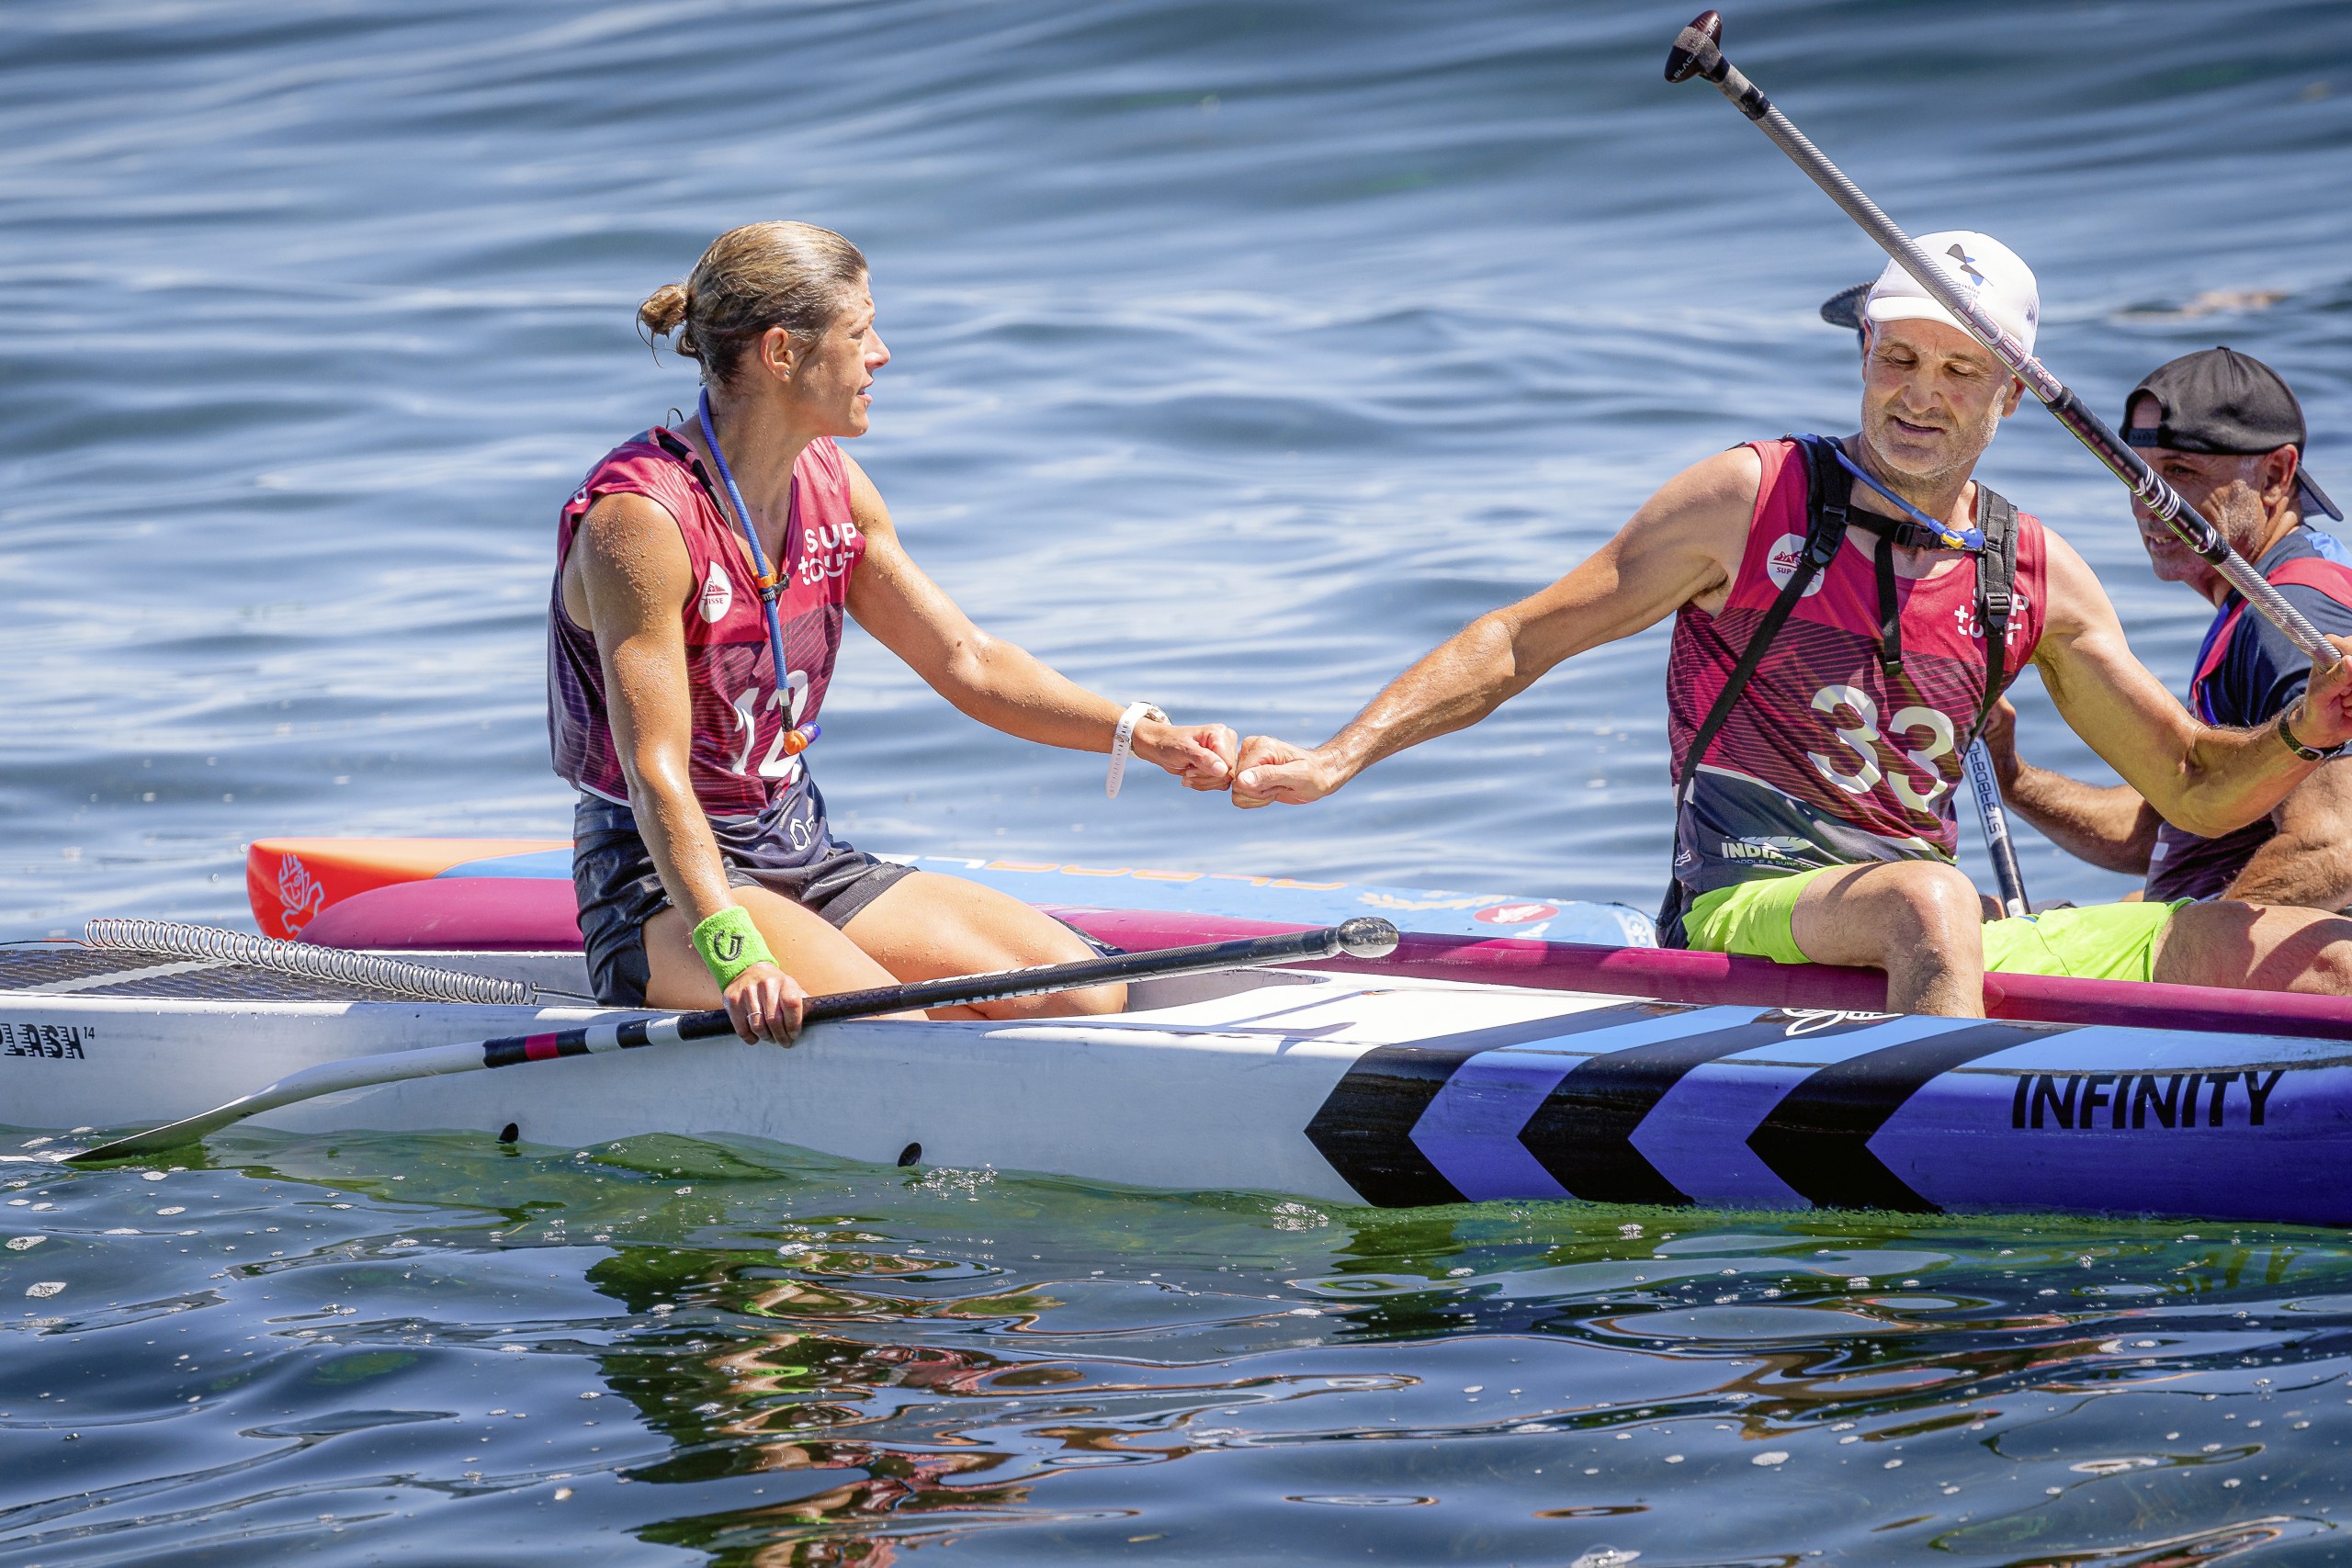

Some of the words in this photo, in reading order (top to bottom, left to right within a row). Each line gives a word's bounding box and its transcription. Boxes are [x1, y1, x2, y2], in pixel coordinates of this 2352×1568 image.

[1673, 51, 1698, 80] BLAC
[804, 522, 857, 554] SUP
[1776, 567, 1792, 575] SUP
[1954, 604, 2023, 646] tor
[731, 670, 808, 778] 12
[1807, 684, 1955, 813] 33
[0, 1023, 85, 1059] LASH
[84, 1026, 96, 1040] 14
[2012, 1068, 2287, 1130] INFINITY
